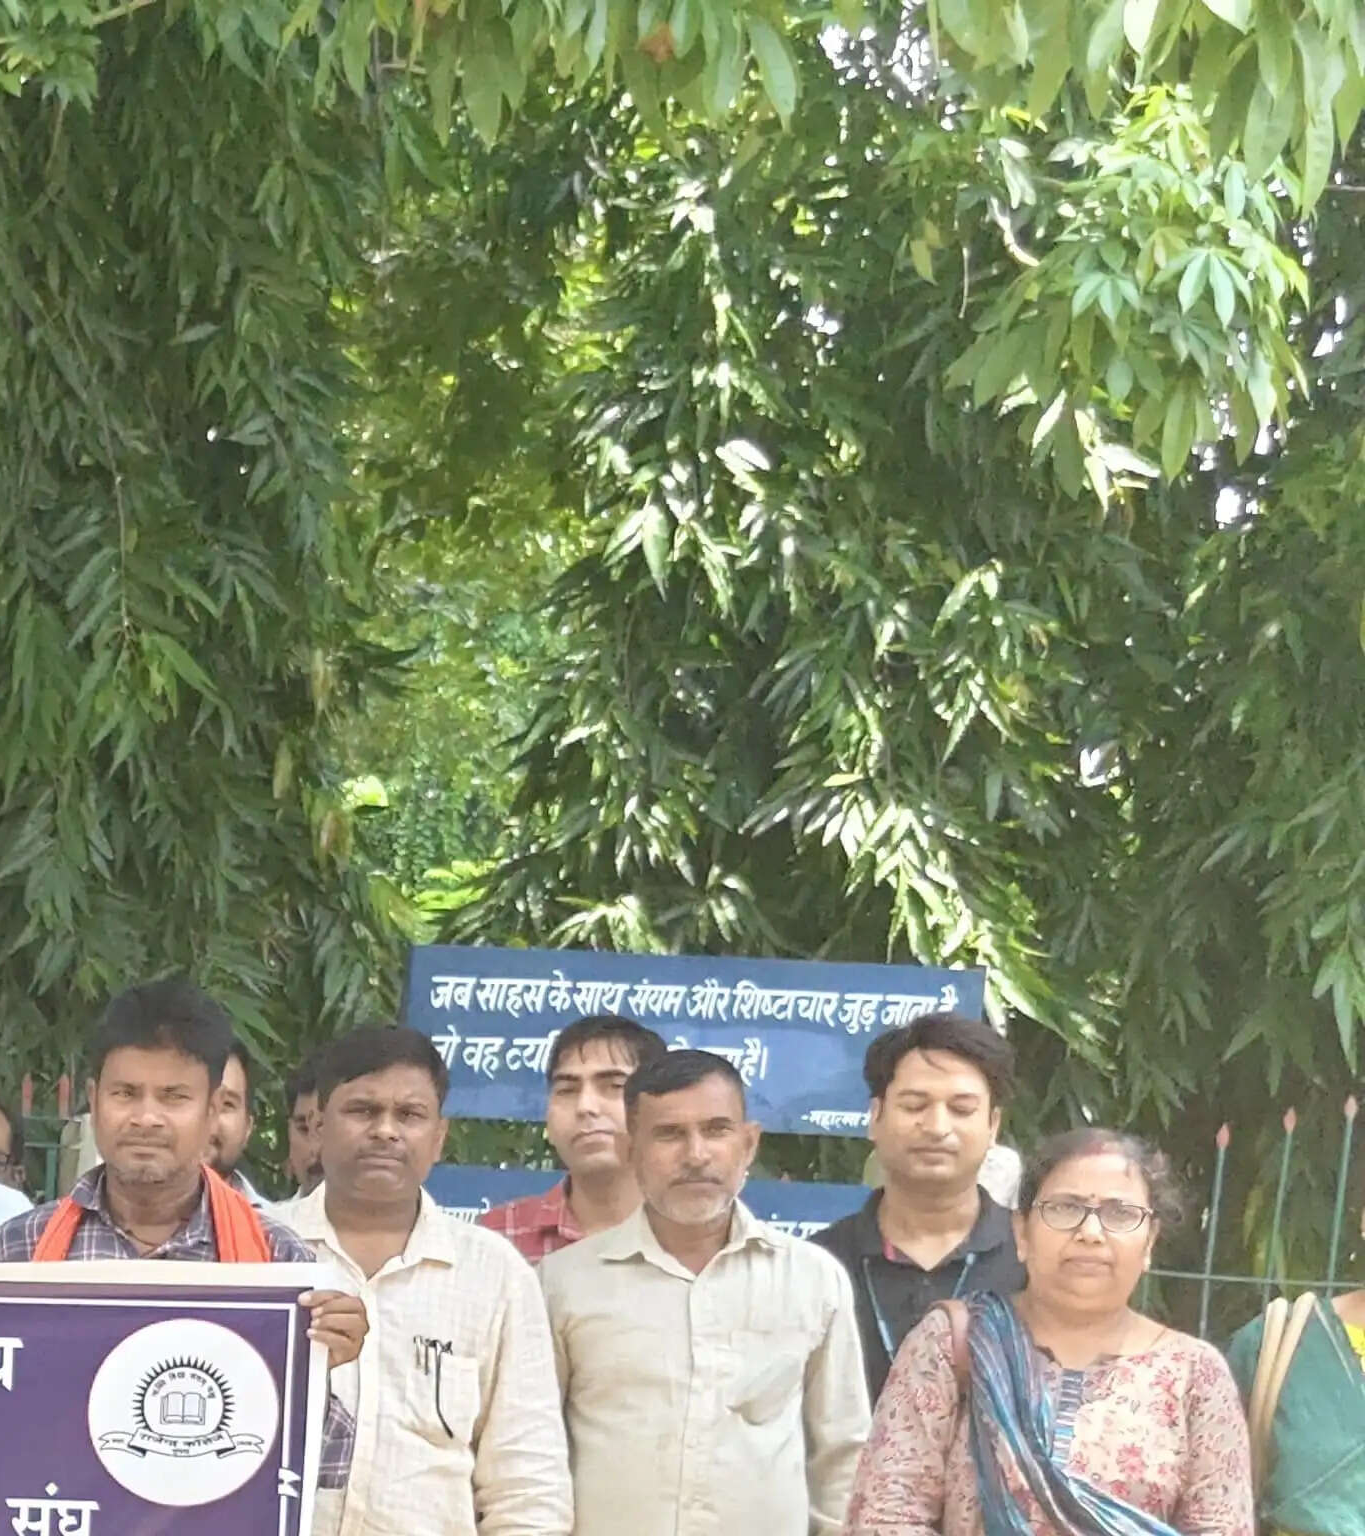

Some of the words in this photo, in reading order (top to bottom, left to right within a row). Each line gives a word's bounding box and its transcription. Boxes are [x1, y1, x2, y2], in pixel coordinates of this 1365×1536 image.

[431, 976, 477, 1010] जब
[476, 978, 550, 1017] साहस
[549, 970, 572, 1012] के
[573, 982, 629, 1015] साथ
[627, 979, 687, 1016] संयम
[687, 979, 730, 1021] और
[462, 1037, 504, 1080] वह
